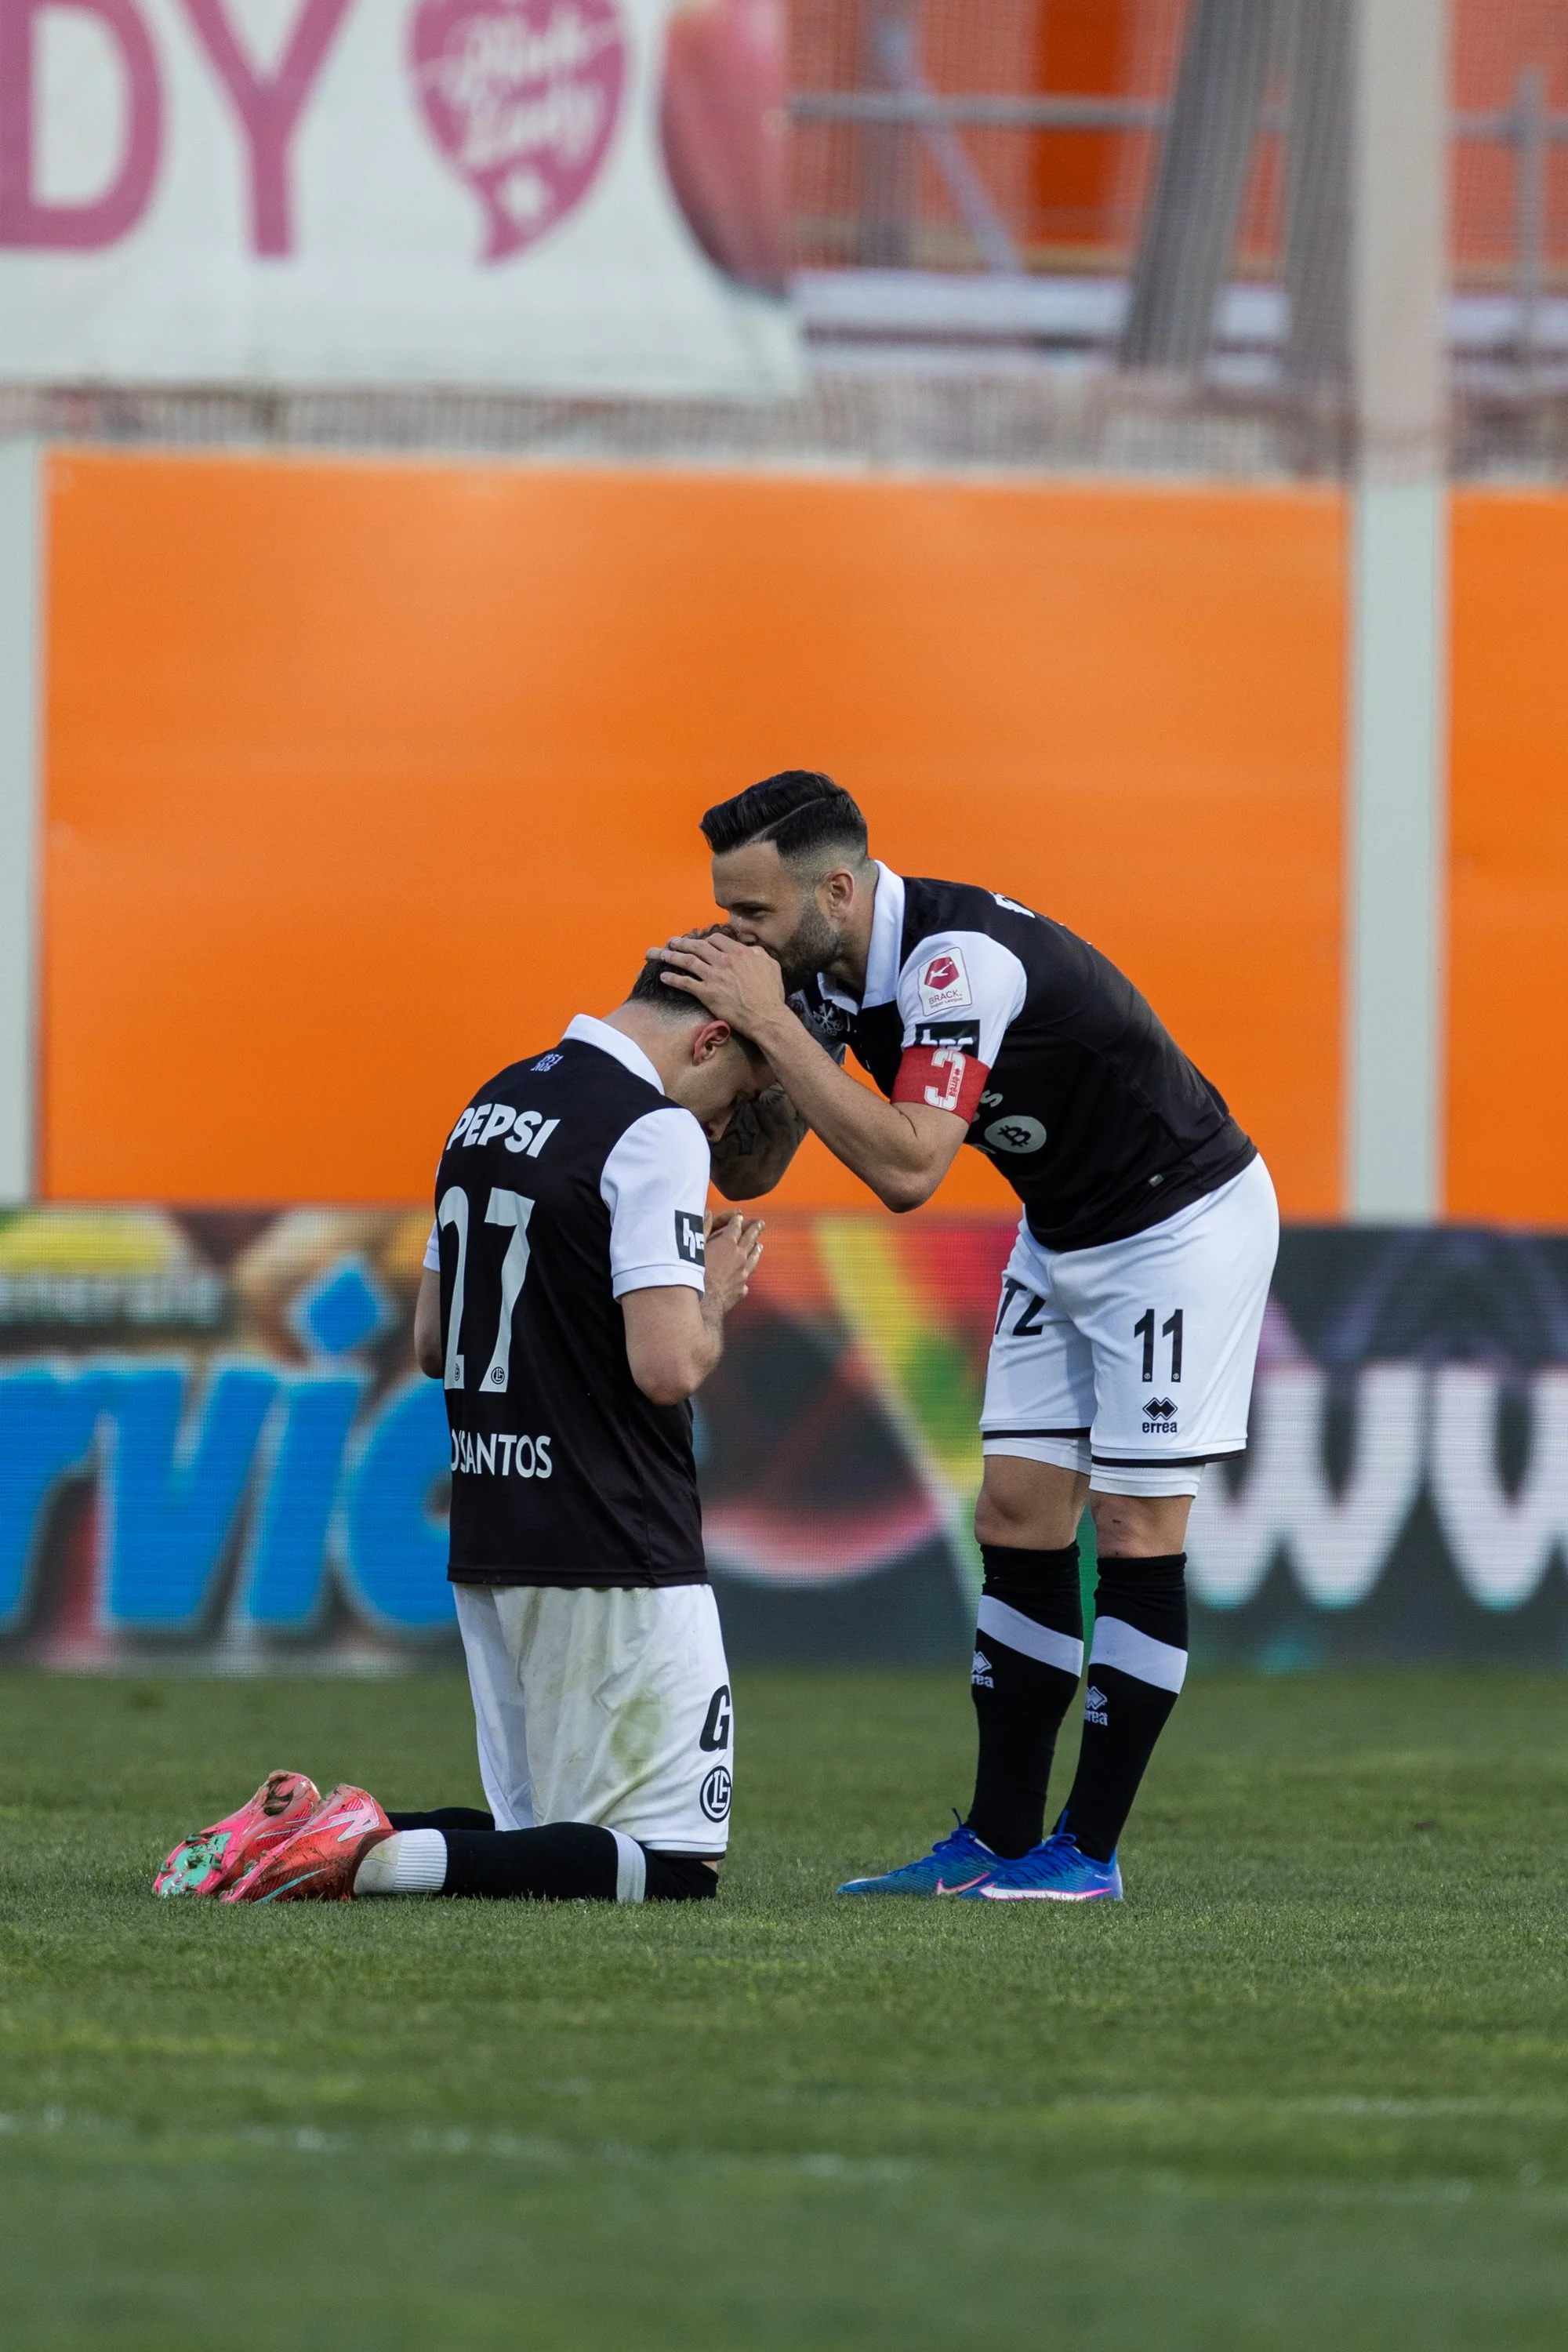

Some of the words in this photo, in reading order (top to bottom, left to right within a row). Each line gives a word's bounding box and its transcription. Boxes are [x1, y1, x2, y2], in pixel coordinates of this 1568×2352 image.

[445, 1103, 561, 1158] PEPSI
[438, 1186, 535, 1392] 27
[1134, 1308, 1183, 1382] 11
[1142, 1421, 1178, 1433] errea
